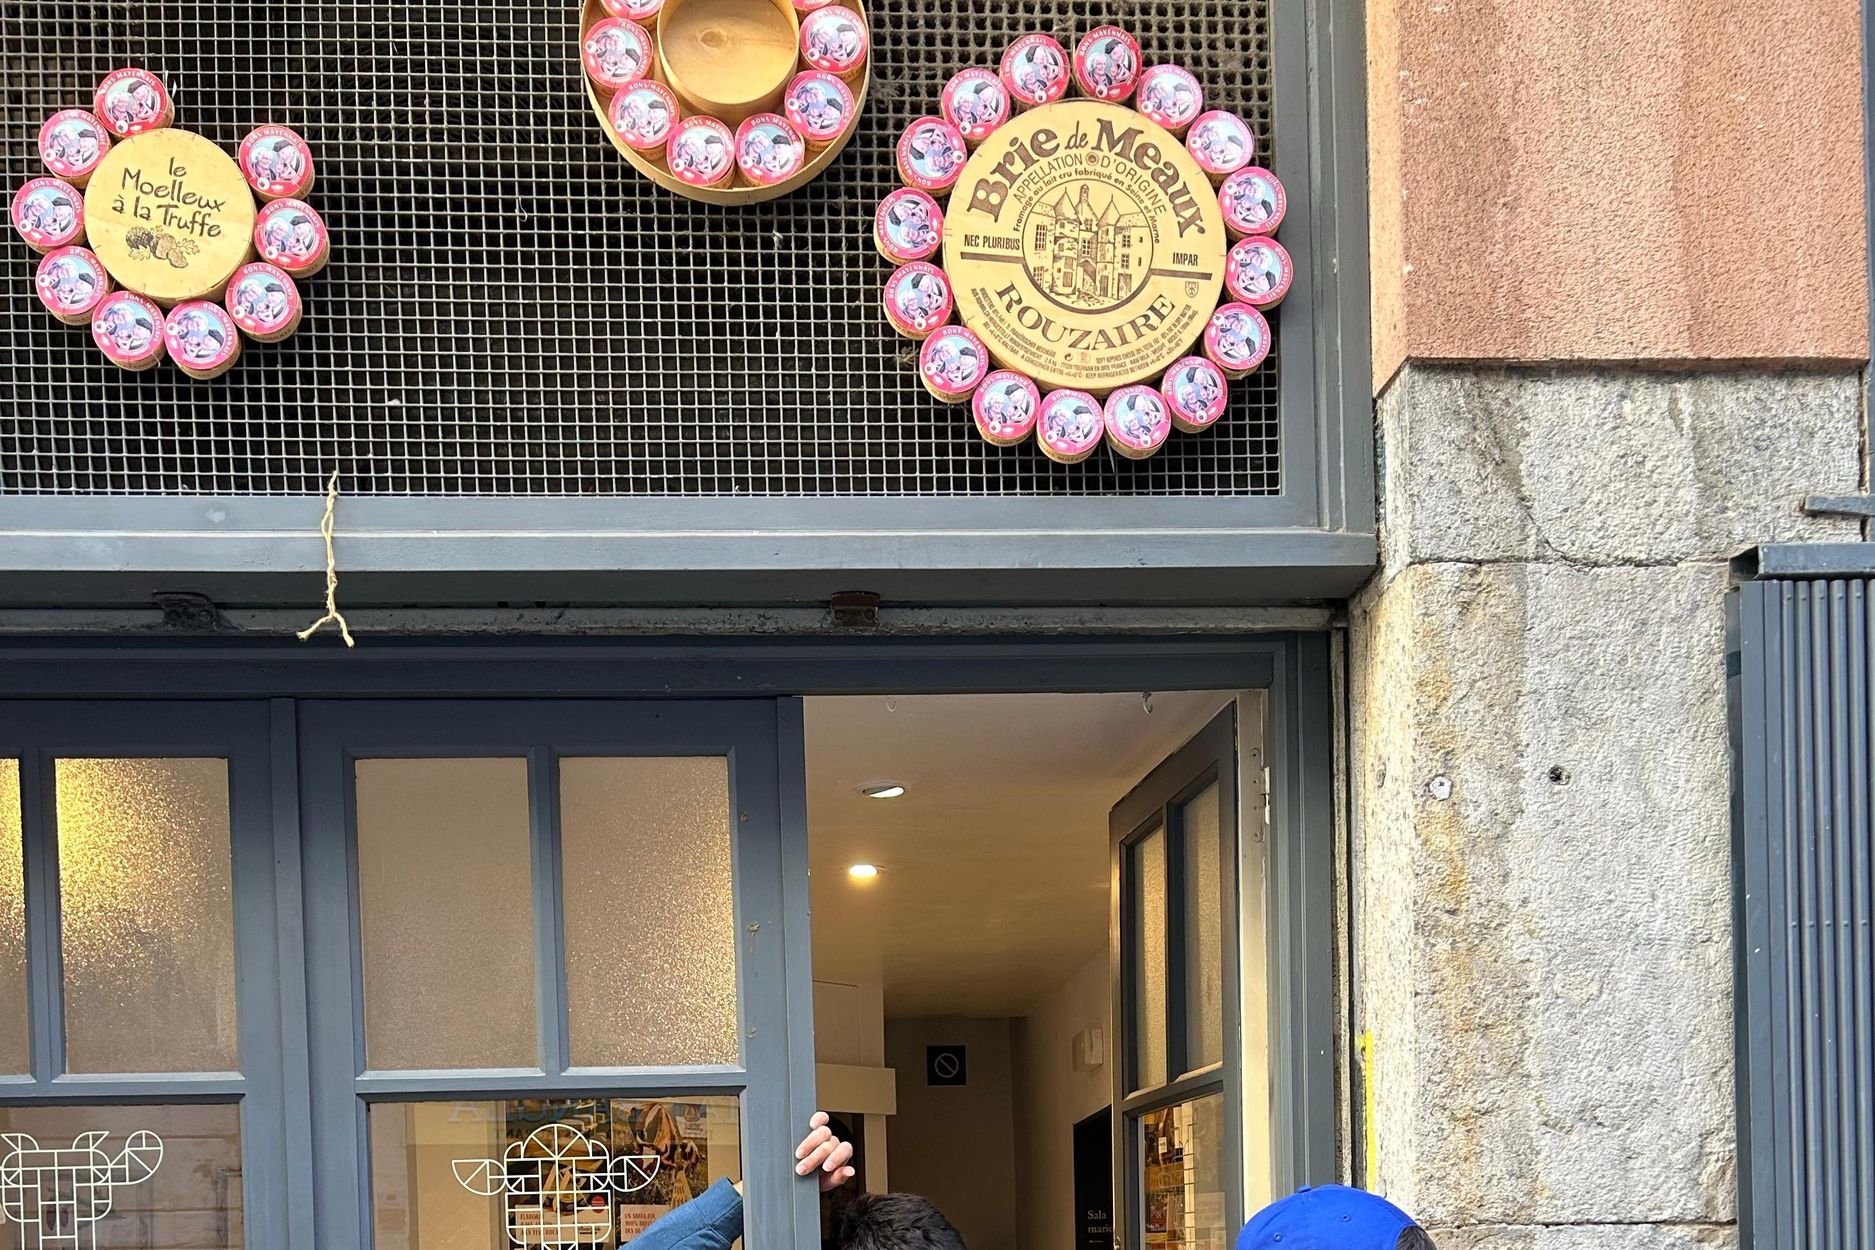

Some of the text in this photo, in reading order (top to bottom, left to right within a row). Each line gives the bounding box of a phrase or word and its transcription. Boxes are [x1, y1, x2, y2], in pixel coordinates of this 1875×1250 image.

[169, 156, 187, 177] le
[967, 129, 1060, 222] Brie
[1065, 120, 1088, 150] de
[1091, 118, 1206, 238] Meaux
[1014, 152, 1167, 215] APPELLATION D'ORIGINE
[122, 167, 226, 212] Moelleux
[1013, 195, 1034, 232] Fromage
[1033, 185, 1043, 196] au
[1044, 176, 1057, 188] lait
[1059, 170, 1072, 180] cru
[1074, 168, 1112, 180] fabriqué
[1114, 178, 1124, 187] en
[1126, 184, 1145, 205] Seine
[112, 194, 221, 237] à la Truffe
[964, 234, 1198, 266] NEC PLURIBUS IMPAR
[995, 280, 1176, 350] ROUZAIRE
[1088, 1210, 1106, 1220] Sala
